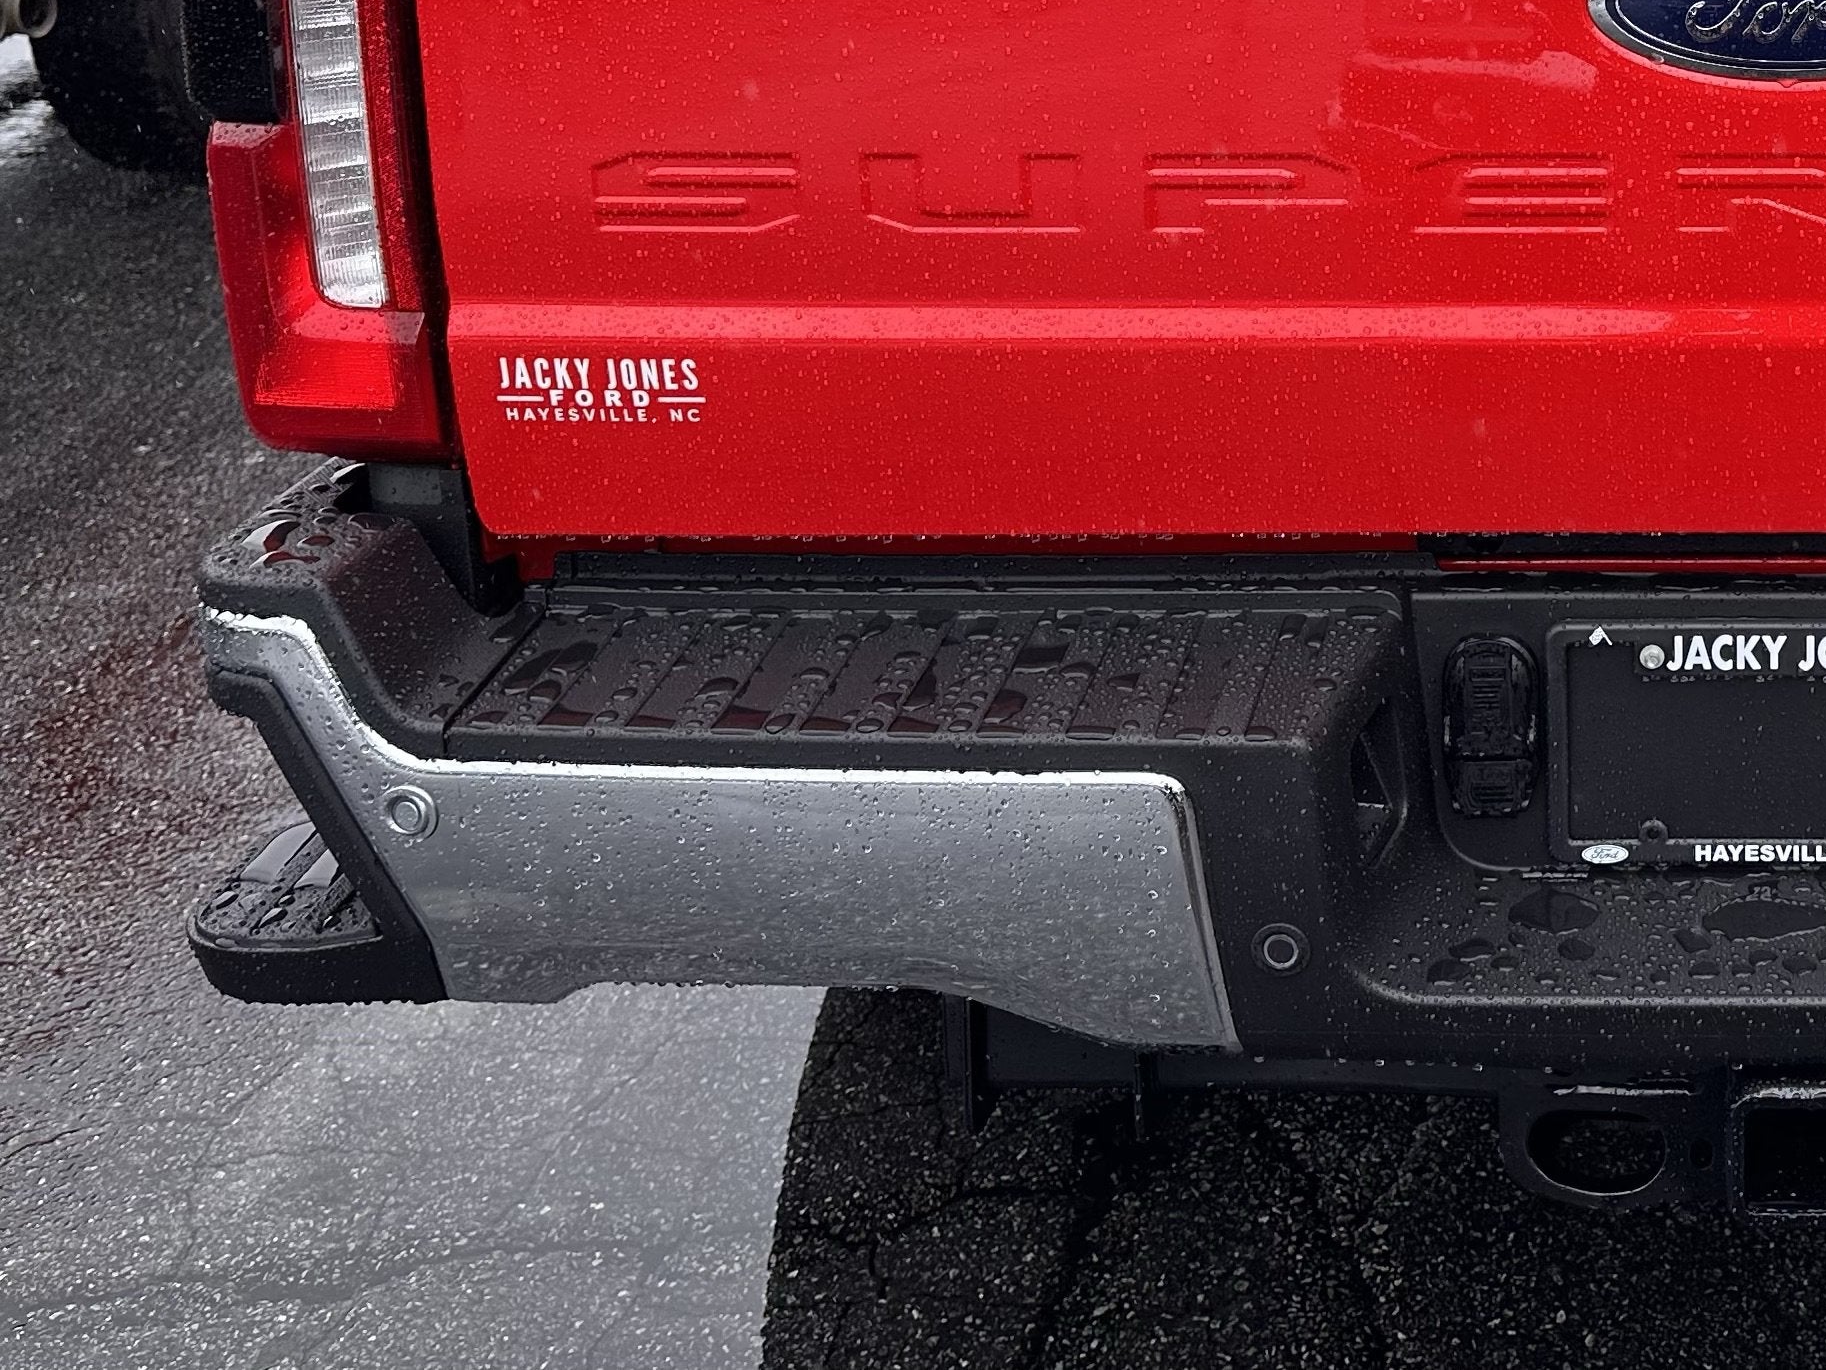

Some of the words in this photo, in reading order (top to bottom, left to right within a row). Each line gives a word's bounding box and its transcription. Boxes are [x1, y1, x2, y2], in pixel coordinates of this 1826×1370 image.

[499, 356, 590, 390] JACKY
[606, 357, 699, 391] JONES
[549, 389, 651, 408] FORD
[505, 407, 658, 424] HAYESVILLE,
[669, 408, 701, 423] NC
[1666, 634, 1787, 672] JACKY
